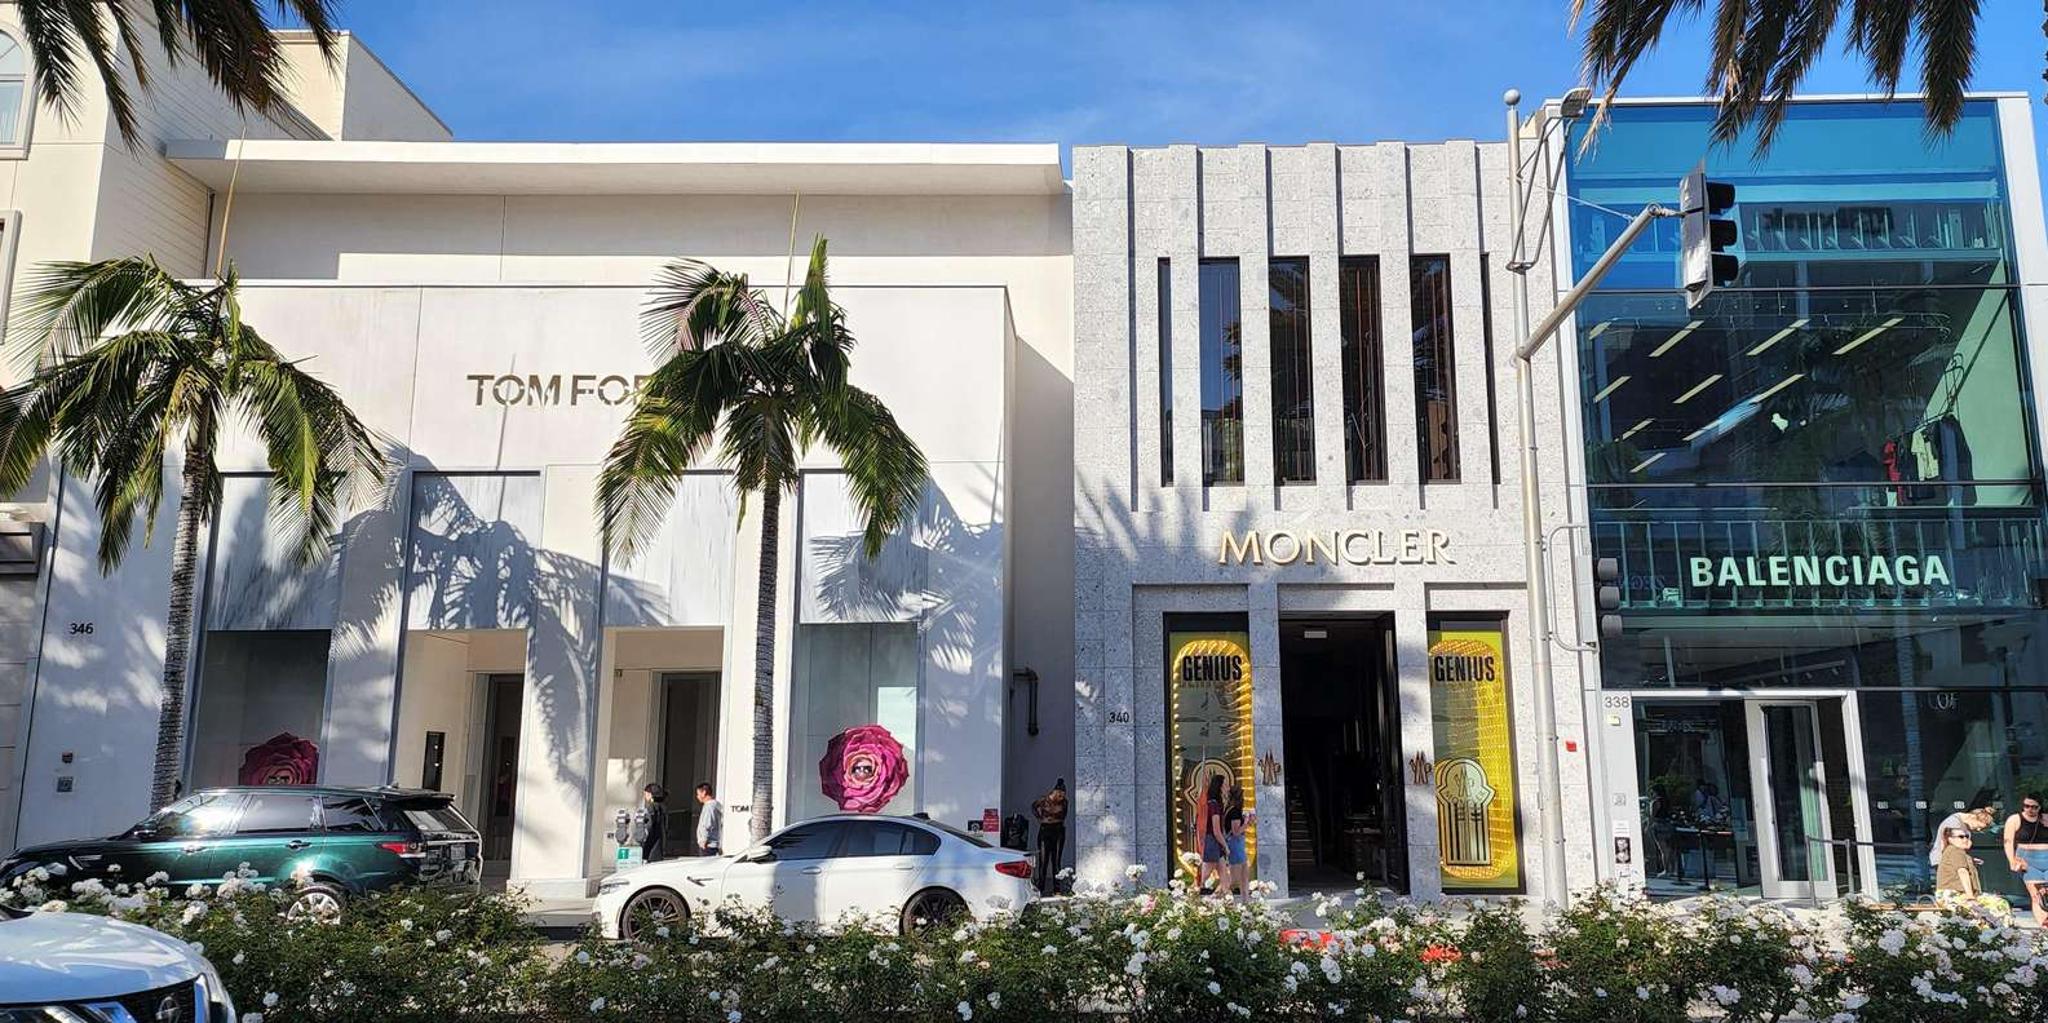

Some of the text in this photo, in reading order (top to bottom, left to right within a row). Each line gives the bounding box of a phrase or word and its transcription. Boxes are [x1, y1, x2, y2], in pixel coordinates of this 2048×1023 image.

[467, 374, 562, 406] TOM
[1218, 529, 1456, 566] MONCLER
[1690, 555, 1950, 587] BALENCIAGA
[69, 622, 94, 635] 346
[1183, 655, 1242, 681] GENIUS
[1434, 655, 1495, 682] GENIUS
[1604, 696, 1630, 709] 338
[1109, 711, 1130, 723] 340
